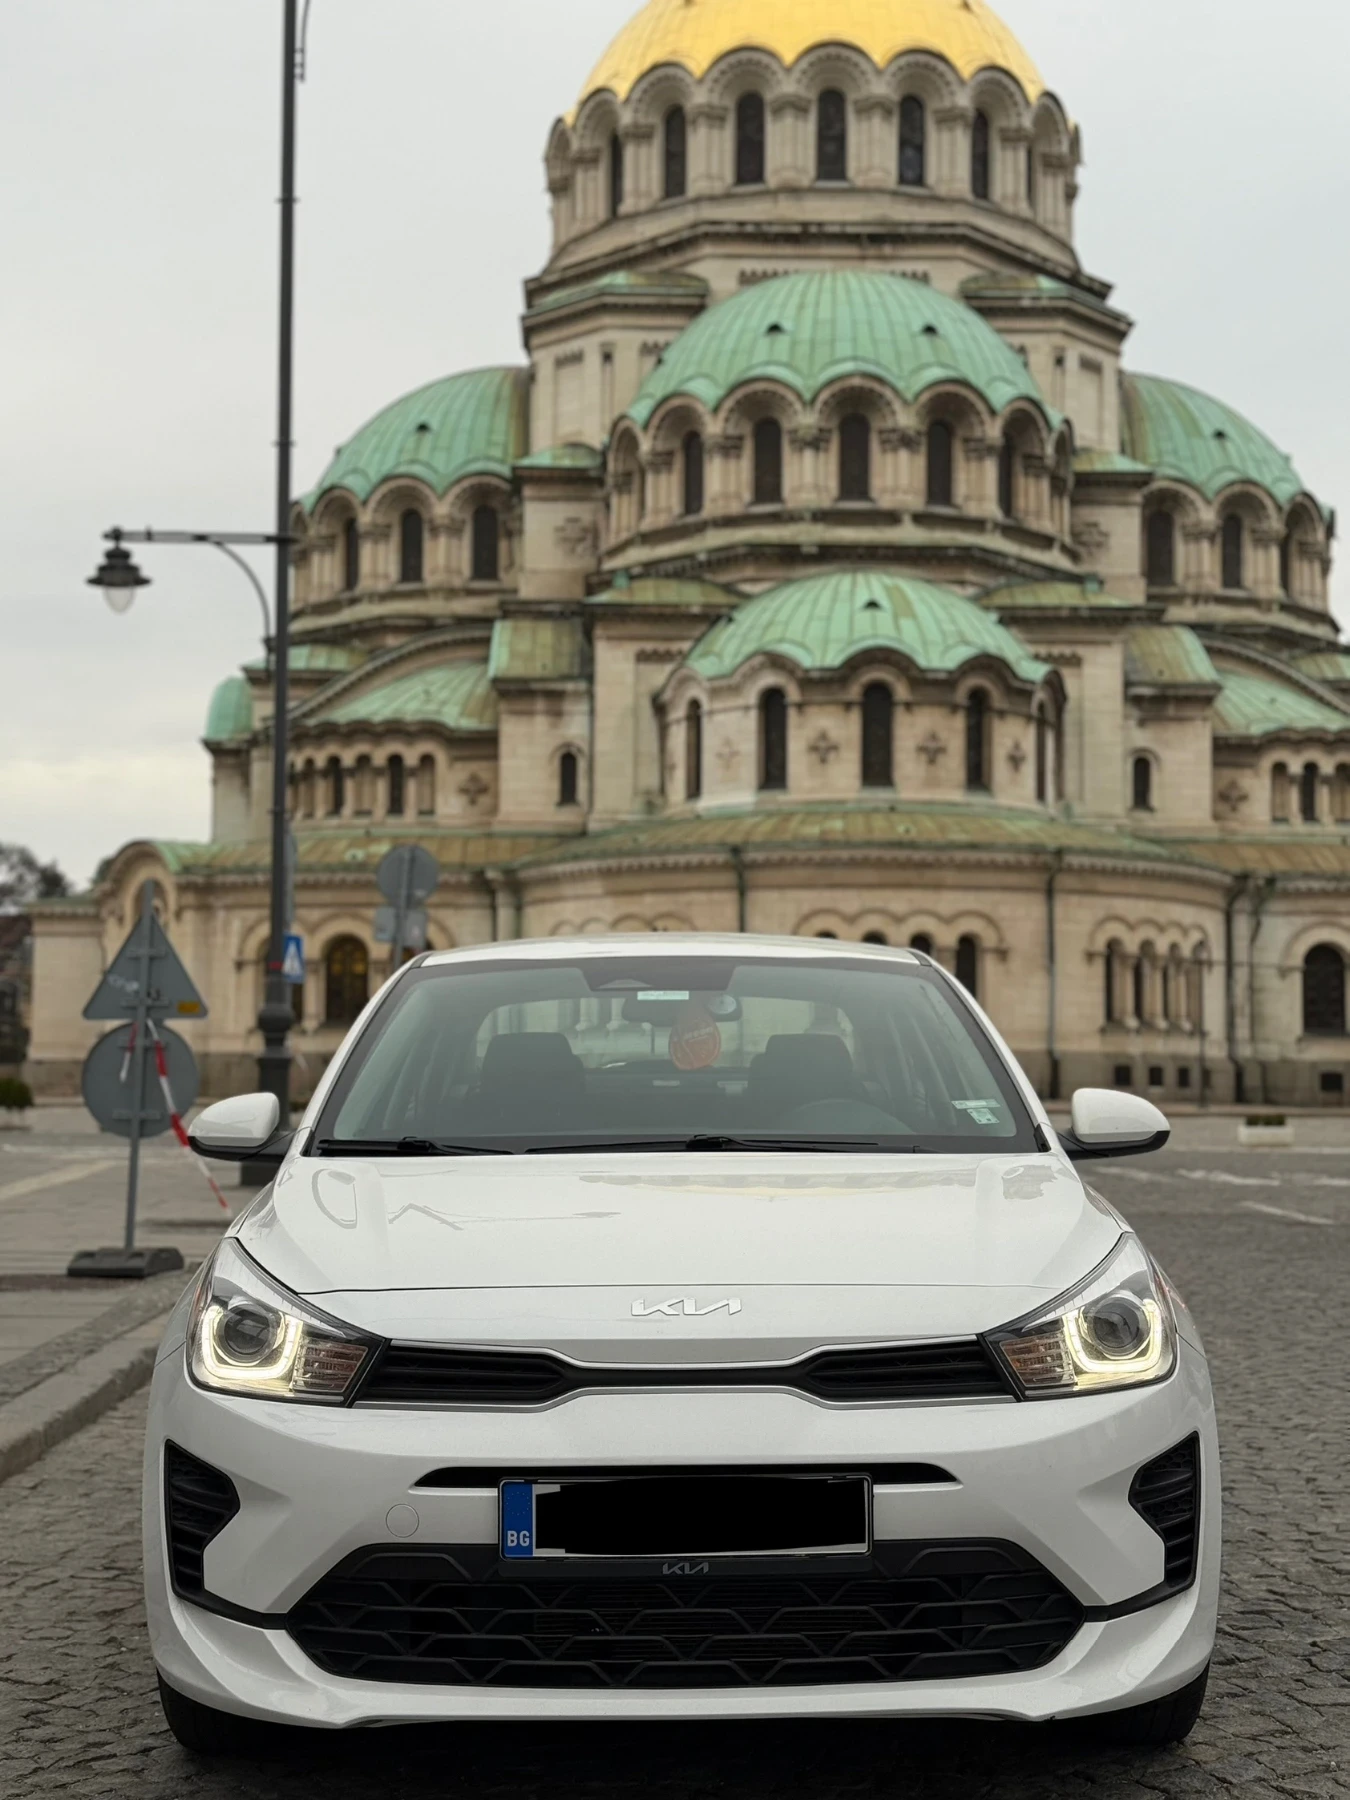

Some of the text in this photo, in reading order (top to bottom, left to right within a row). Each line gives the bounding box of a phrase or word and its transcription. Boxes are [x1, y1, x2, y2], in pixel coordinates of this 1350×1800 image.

[631, 1297, 742, 1316] KIA
[507, 1531, 530, 1547] BG
[662, 1562, 709, 1575] KIA
